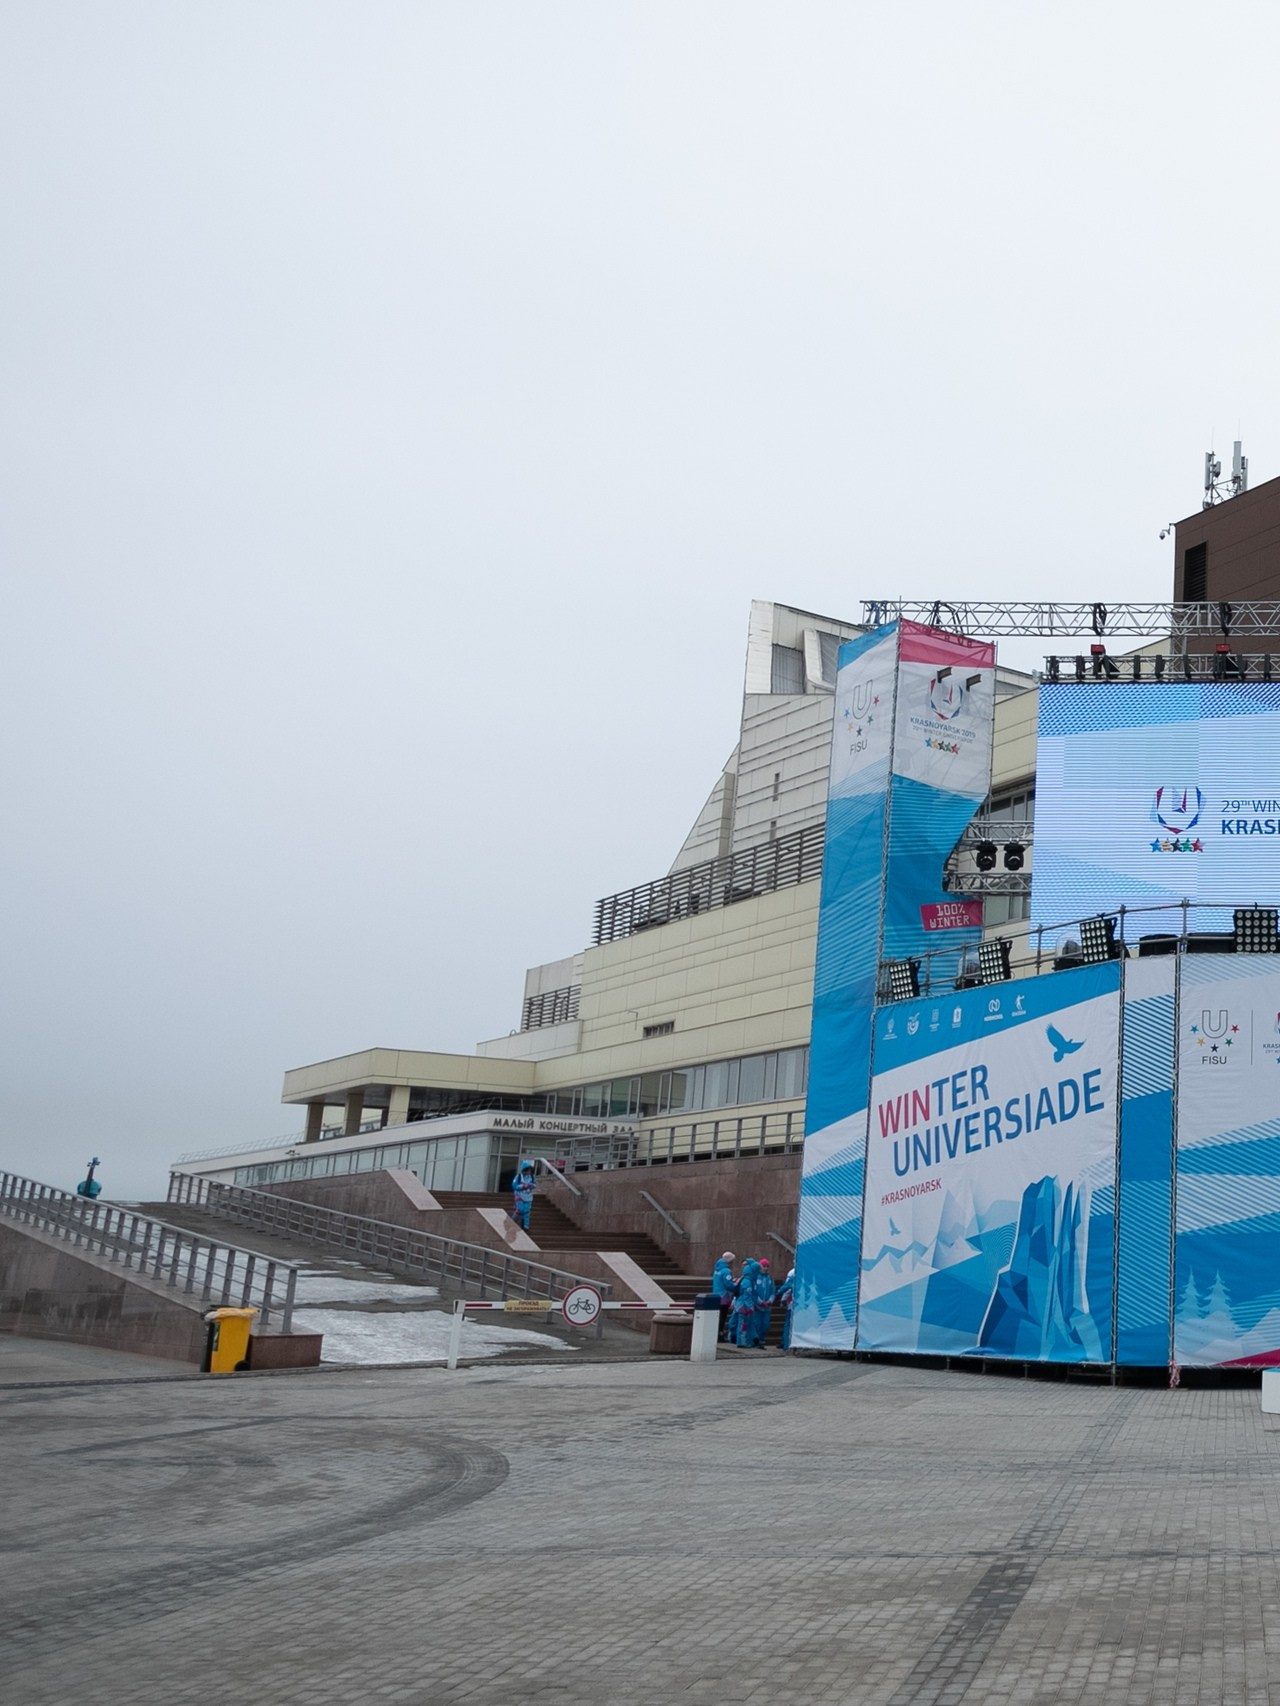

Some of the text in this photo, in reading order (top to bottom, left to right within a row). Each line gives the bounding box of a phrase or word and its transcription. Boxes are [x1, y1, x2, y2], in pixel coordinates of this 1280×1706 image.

[849, 739, 868, 755] FISU
[936, 903, 966, 917] 100%
[930, 914, 970, 929] WINTER
[1201, 1056, 1227, 1065] FISU
[878, 1064, 989, 1138] WINTER
[493, 1118, 534, 1129] МАЛЫЙ
[539, 1120, 607, 1133] КОНЦЕРТНЫЙ
[892, 1068, 1105, 1177] UNIVERSIADE
[881, 1177, 942, 1207] #KRASNOYARSK
